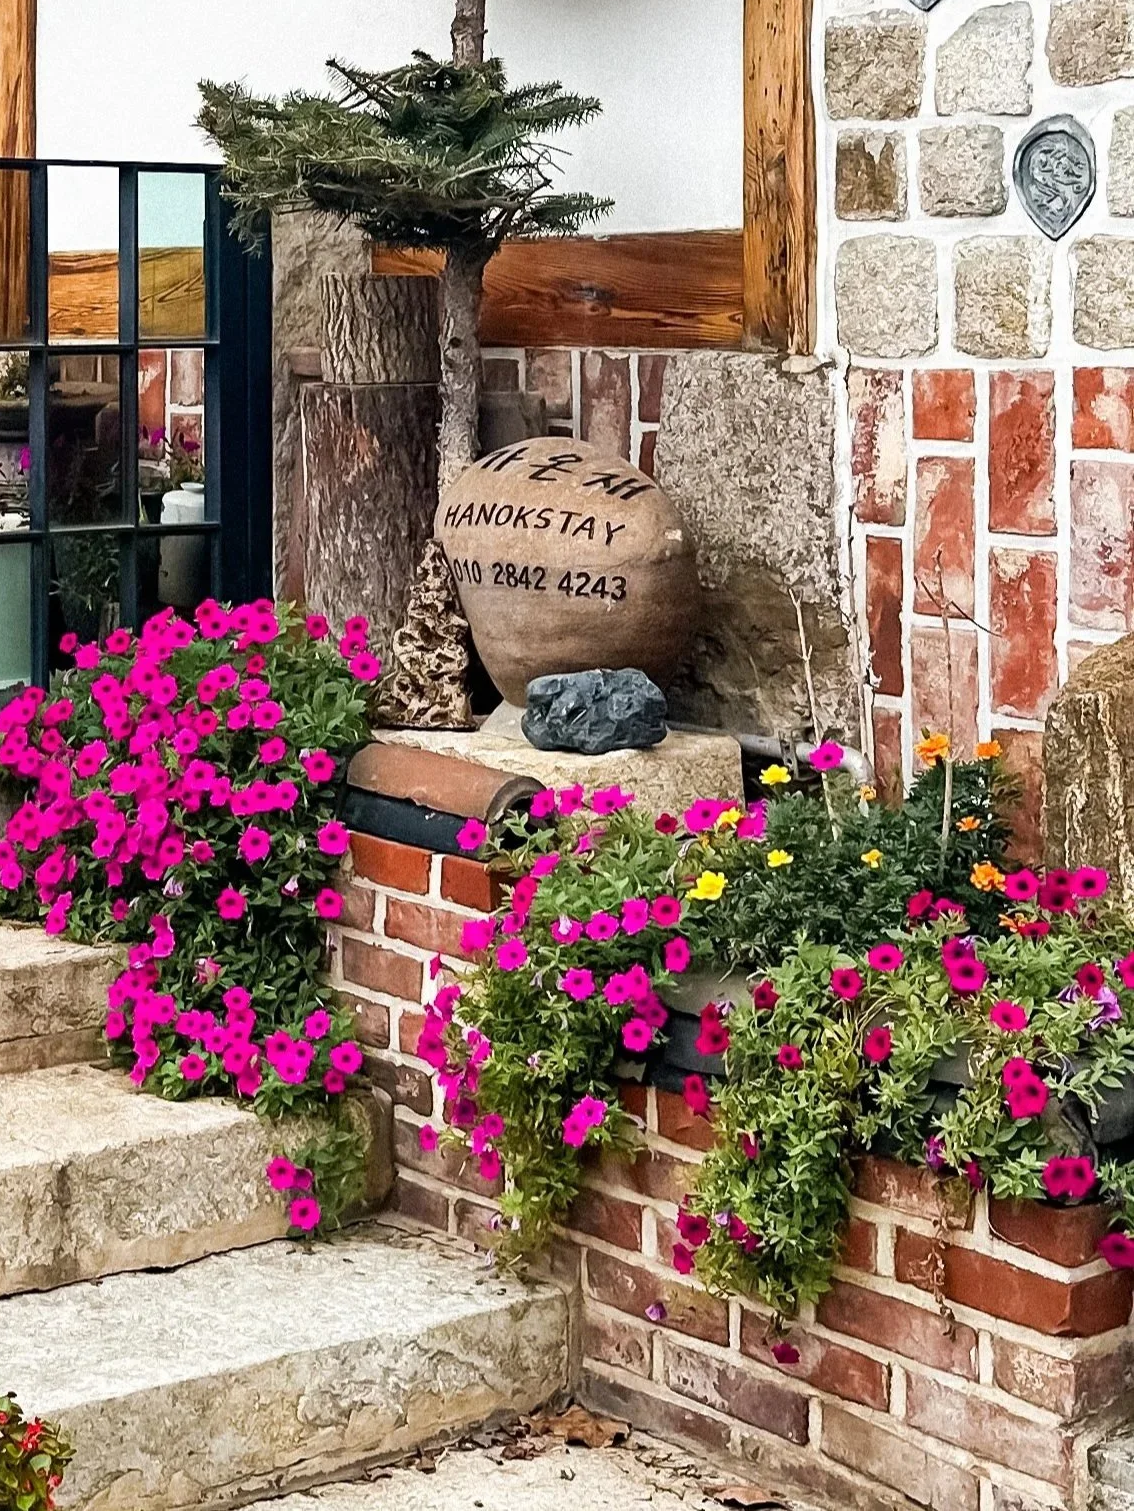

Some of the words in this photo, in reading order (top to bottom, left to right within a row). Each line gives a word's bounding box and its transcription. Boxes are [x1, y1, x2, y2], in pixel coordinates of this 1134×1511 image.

[443, 502, 626, 546] HANOKSTAY
[452, 558, 482, 585] 010
[491, 561, 547, 591] 2842
[557, 570, 628, 602] 4243
